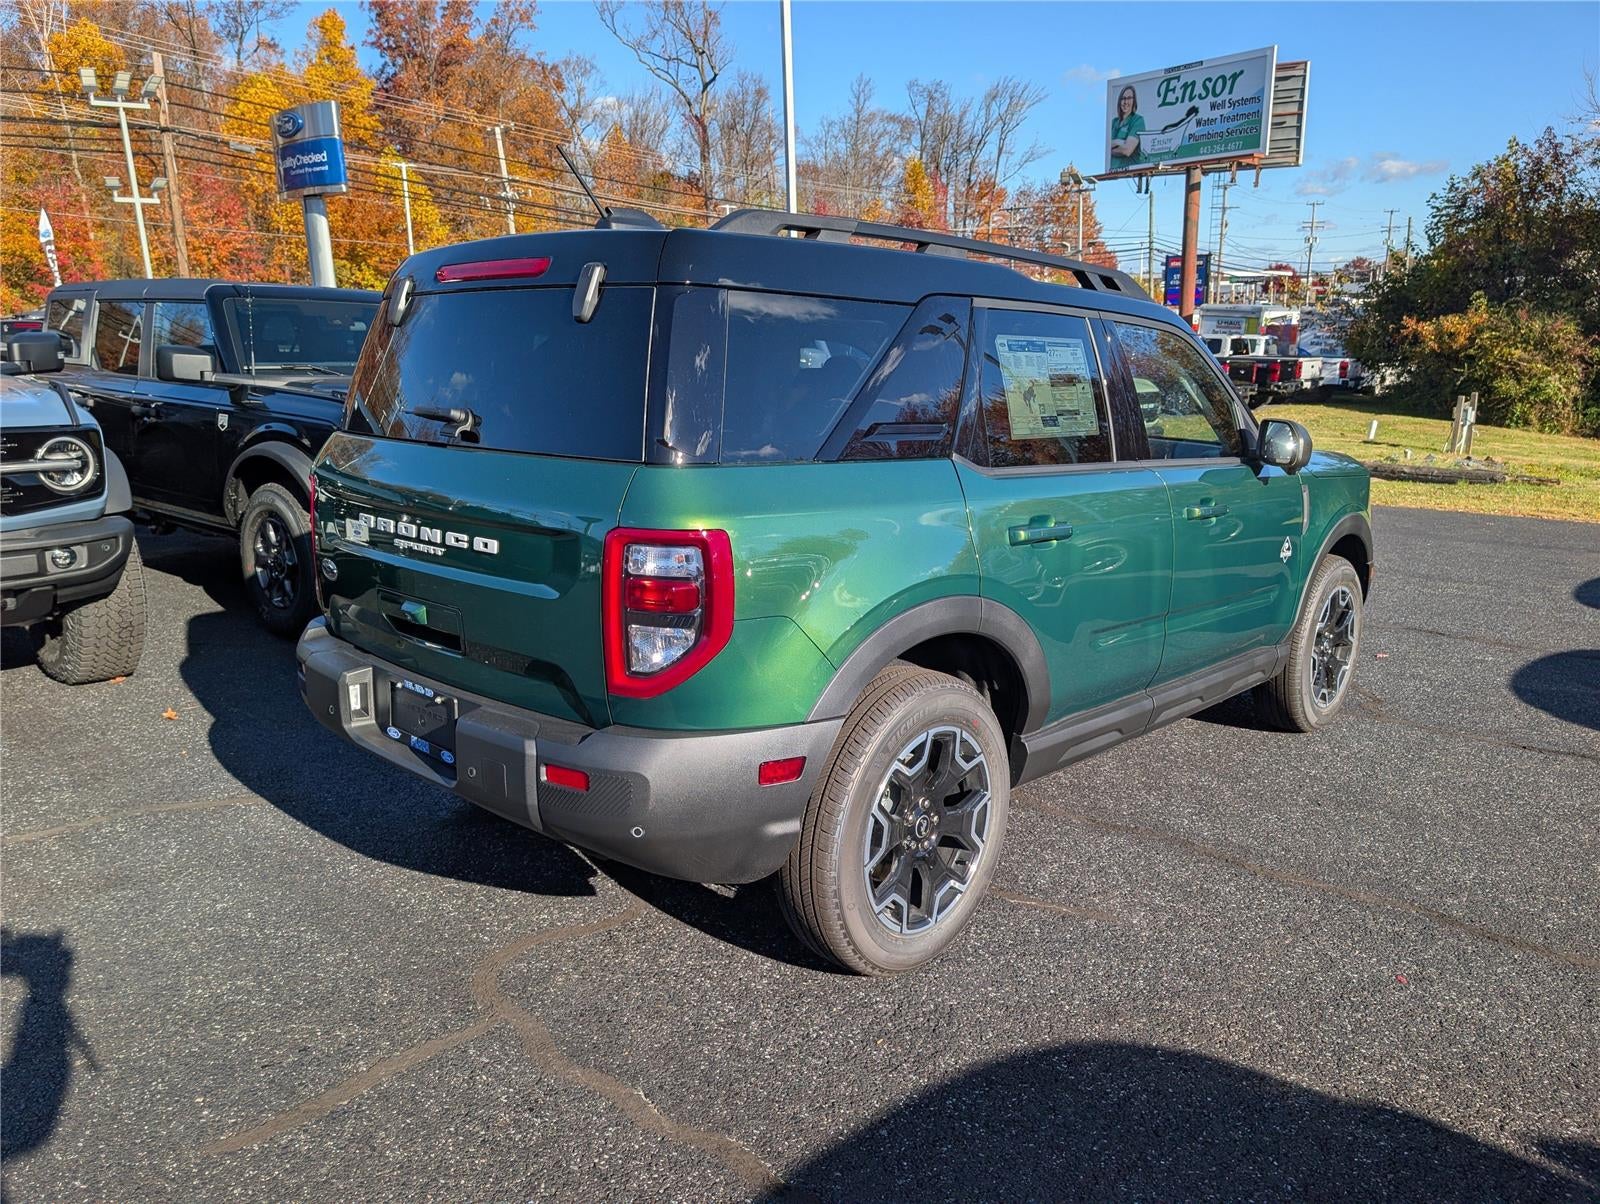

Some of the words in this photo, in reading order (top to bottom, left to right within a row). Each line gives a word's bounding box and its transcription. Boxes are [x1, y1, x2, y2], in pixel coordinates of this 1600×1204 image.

[1157, 69, 1244, 108] Ensor
[1209, 100, 1226, 111] Well
[1228, 95, 1261, 110] Systems
[1195, 116, 1217, 128] Water
[1220, 109, 1260, 124] Treatment
[1188, 129, 1223, 143] Plumbing
[1226, 124, 1259, 137] Services
[359, 512, 500, 555] BRONCO
[393, 538, 446, 556] SPORT
